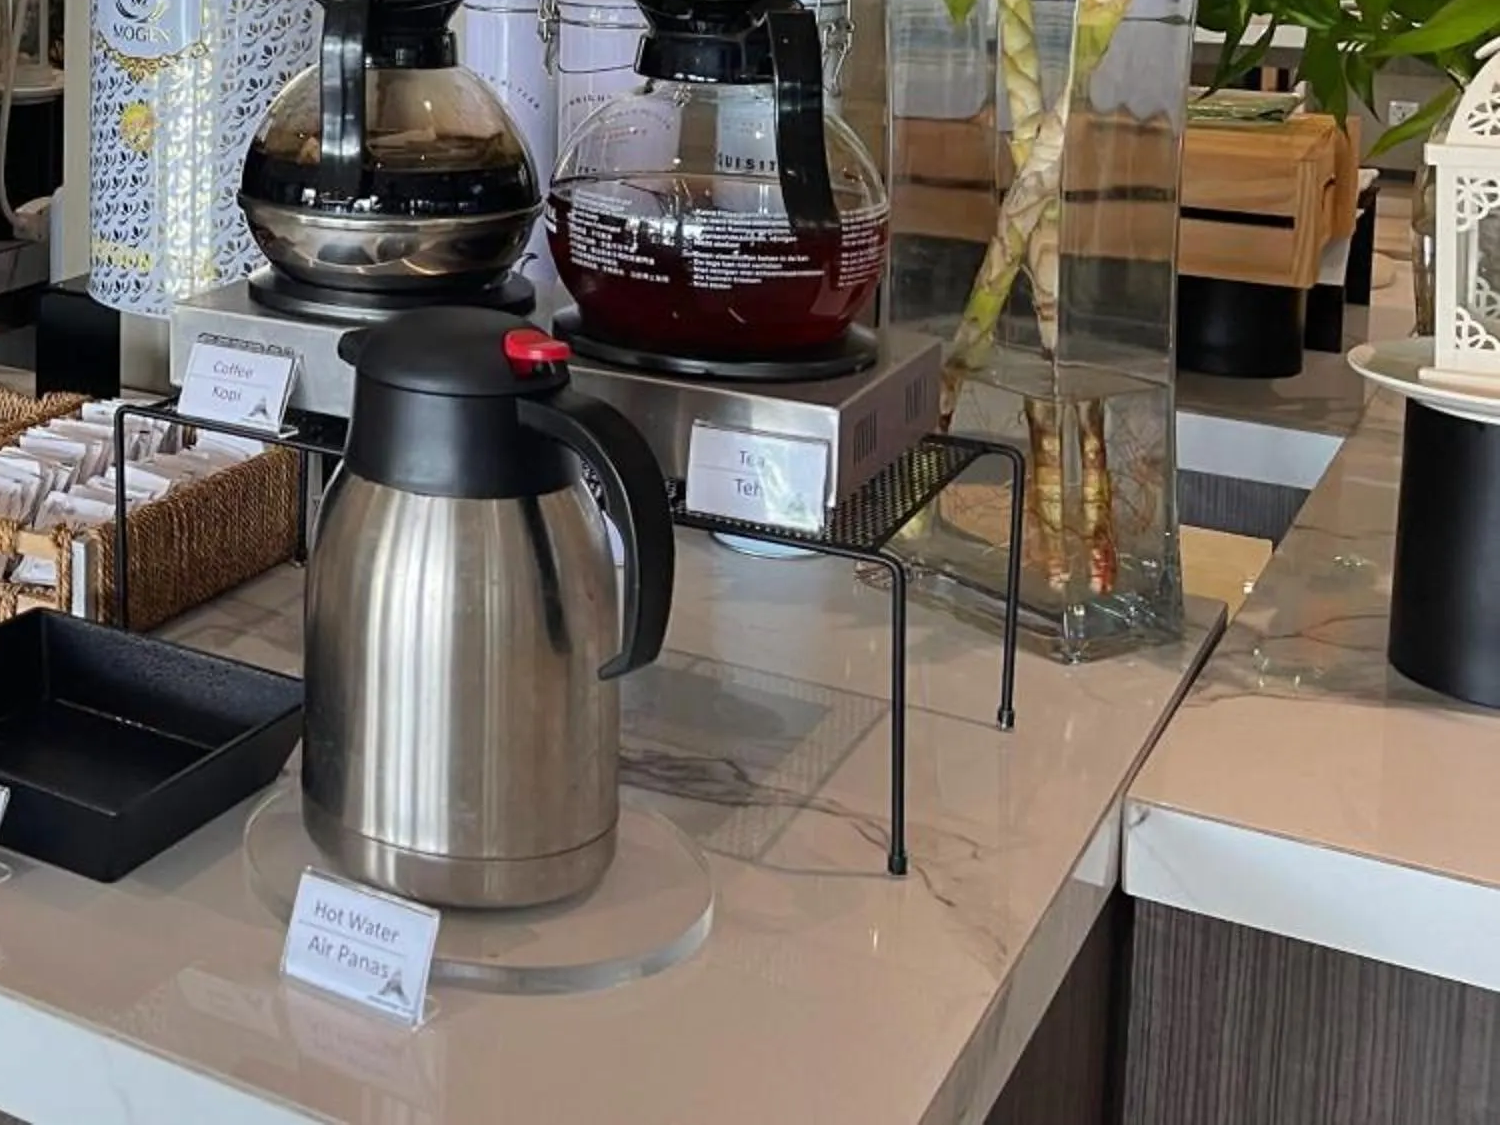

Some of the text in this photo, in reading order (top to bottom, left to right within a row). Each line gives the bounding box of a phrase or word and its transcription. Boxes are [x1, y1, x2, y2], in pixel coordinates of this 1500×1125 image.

[213, 360, 254, 379] Coffee
[212, 386, 242, 402] Kopi
[739, 450, 765, 468] Tea
[735, 478, 763, 496] Teh
[313, 899, 400, 945] Hot Water
[307, 935, 389, 979] Air Panas
